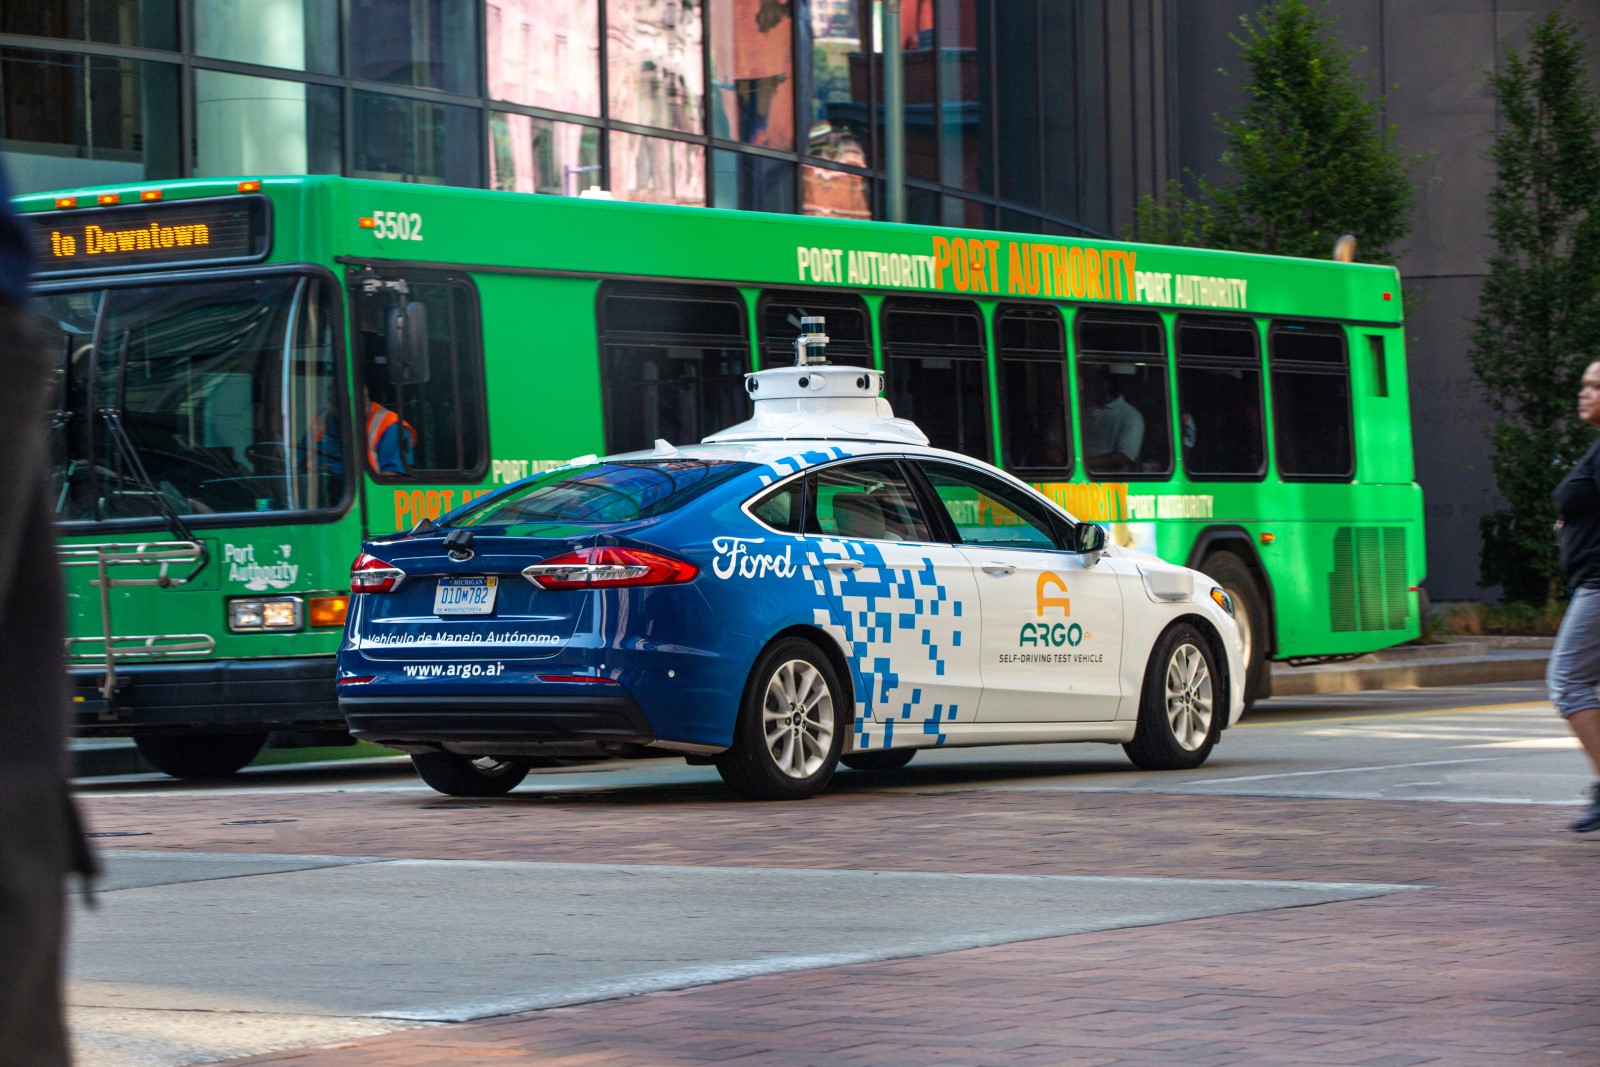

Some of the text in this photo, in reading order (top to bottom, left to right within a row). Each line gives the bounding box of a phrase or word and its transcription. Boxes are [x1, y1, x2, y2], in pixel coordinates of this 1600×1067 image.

[373, 210, 423, 241] 5502
[51, 223, 209, 256] to Downtown
[797, 246, 937, 289] PORT AUTHORITY
[932, 235, 1137, 302] PORT AUTHORITY
[1134, 271, 1247, 309] PORT AUTHORITY
[492, 459, 528, 485] PORT
[394, 489, 454, 531] PORT
[1126, 495, 1214, 519] PORT AUTHORITY
[224, 543, 255, 563] Port
[712, 536, 797, 580] Ford
[228, 562, 299, 584] Authority
[441, 587, 489, 604] 010M782
[368, 630, 561, 646] Vehículo de Manejo Autónomo
[1019, 622, 1092, 647] ARGO AI
[406, 662, 502, 678] www.argo.ai
[999, 654, 1103, 663] SELF-DRIVING TEST VEHICLE
